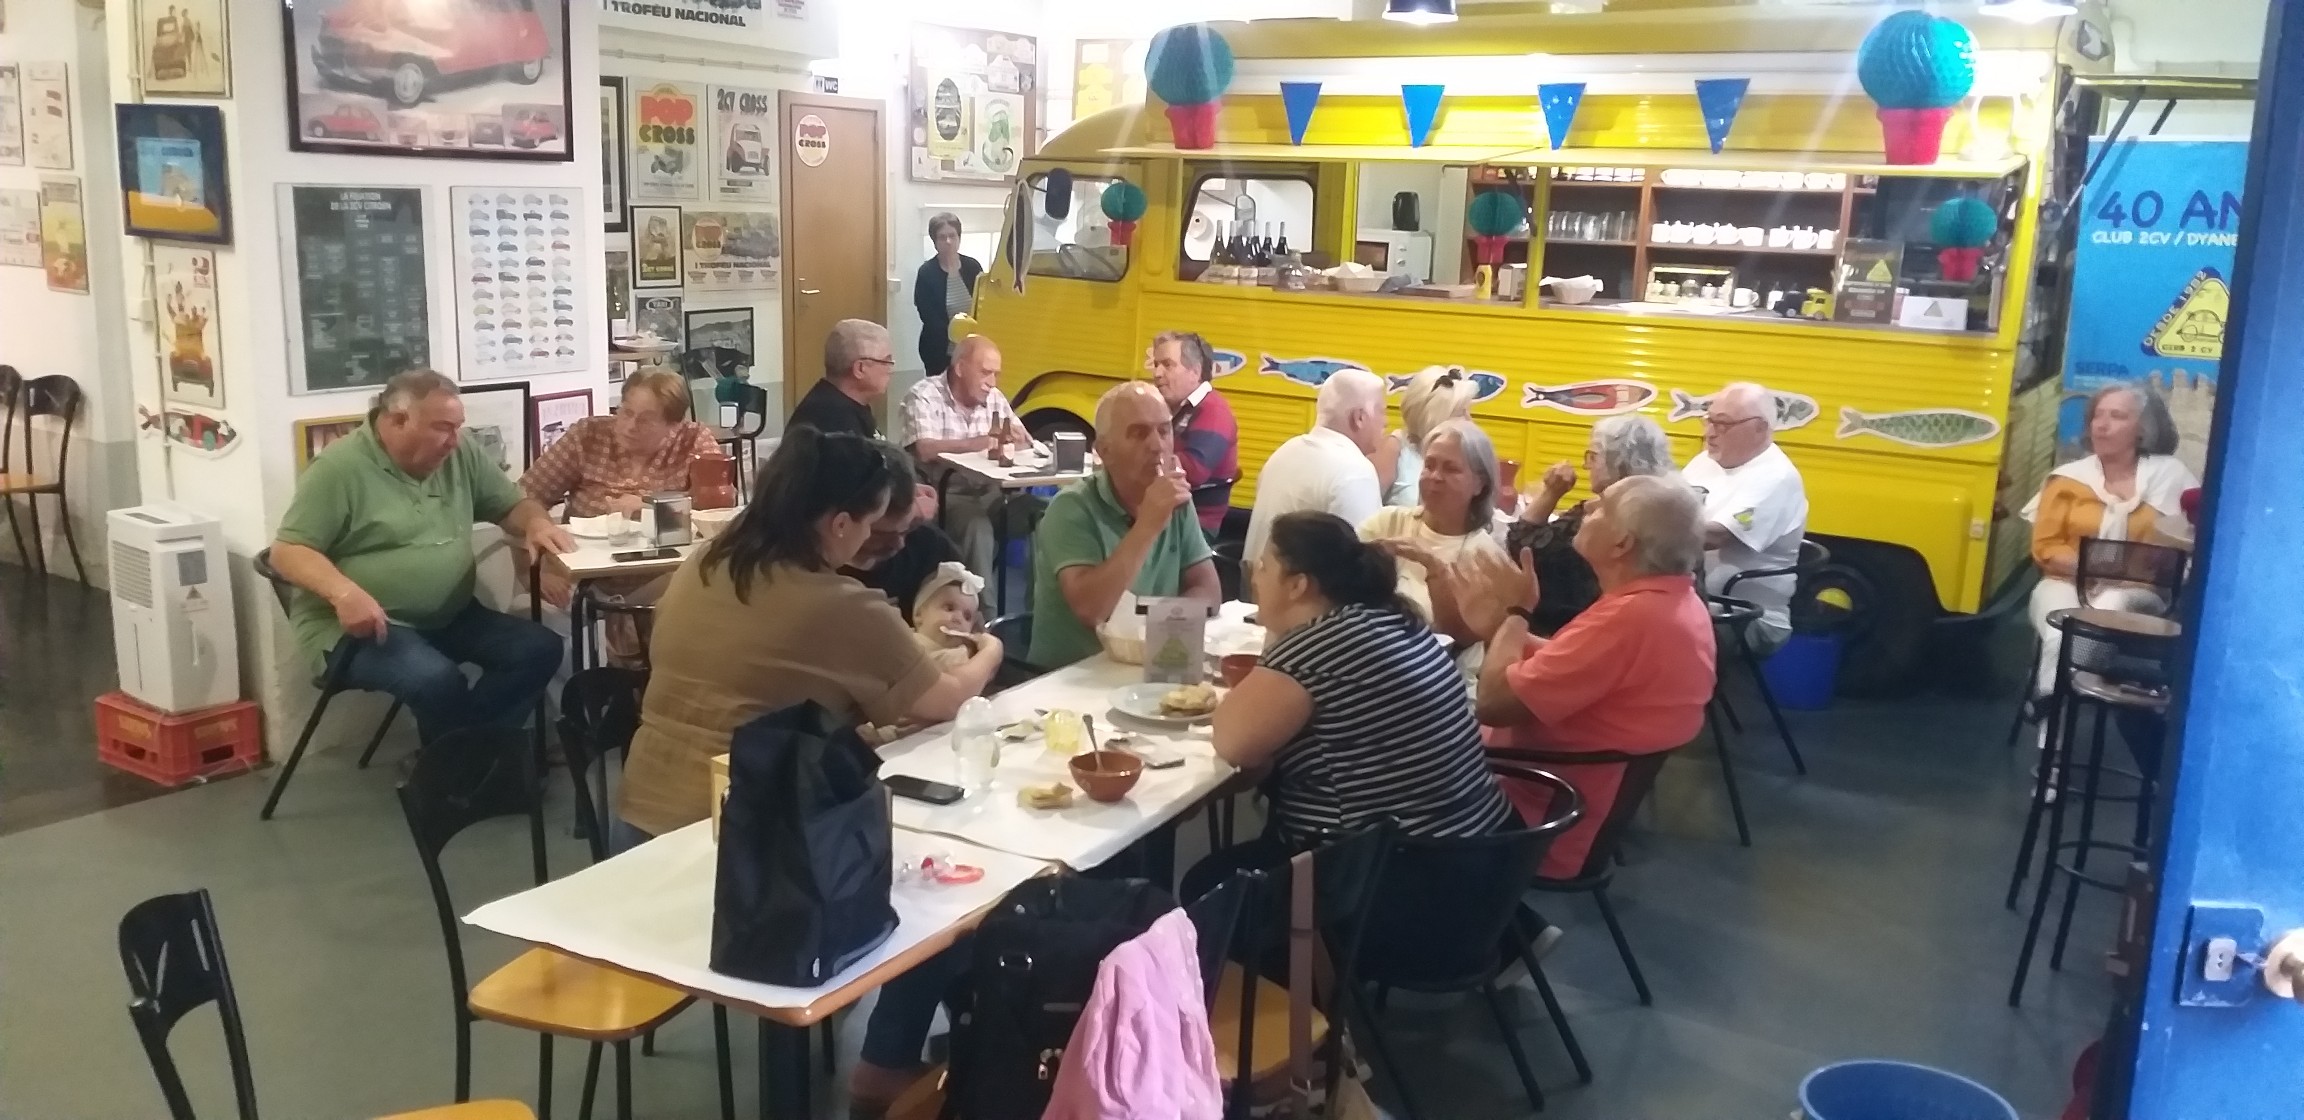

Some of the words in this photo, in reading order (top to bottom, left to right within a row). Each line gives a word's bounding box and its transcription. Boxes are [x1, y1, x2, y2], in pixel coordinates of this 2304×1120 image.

[674, 8, 746, 27] NACIONAL
[825, 80, 838, 89] WC
[641, 96, 693, 126] POP
[639, 124, 695, 145] CROSS
[800, 124, 826, 138] POP
[799, 139, 826, 149] CROSS
[2098, 190, 2164, 228] 40
[2092, 231, 2133, 244] CLUB
[2139, 232, 2171, 245] 2CV
